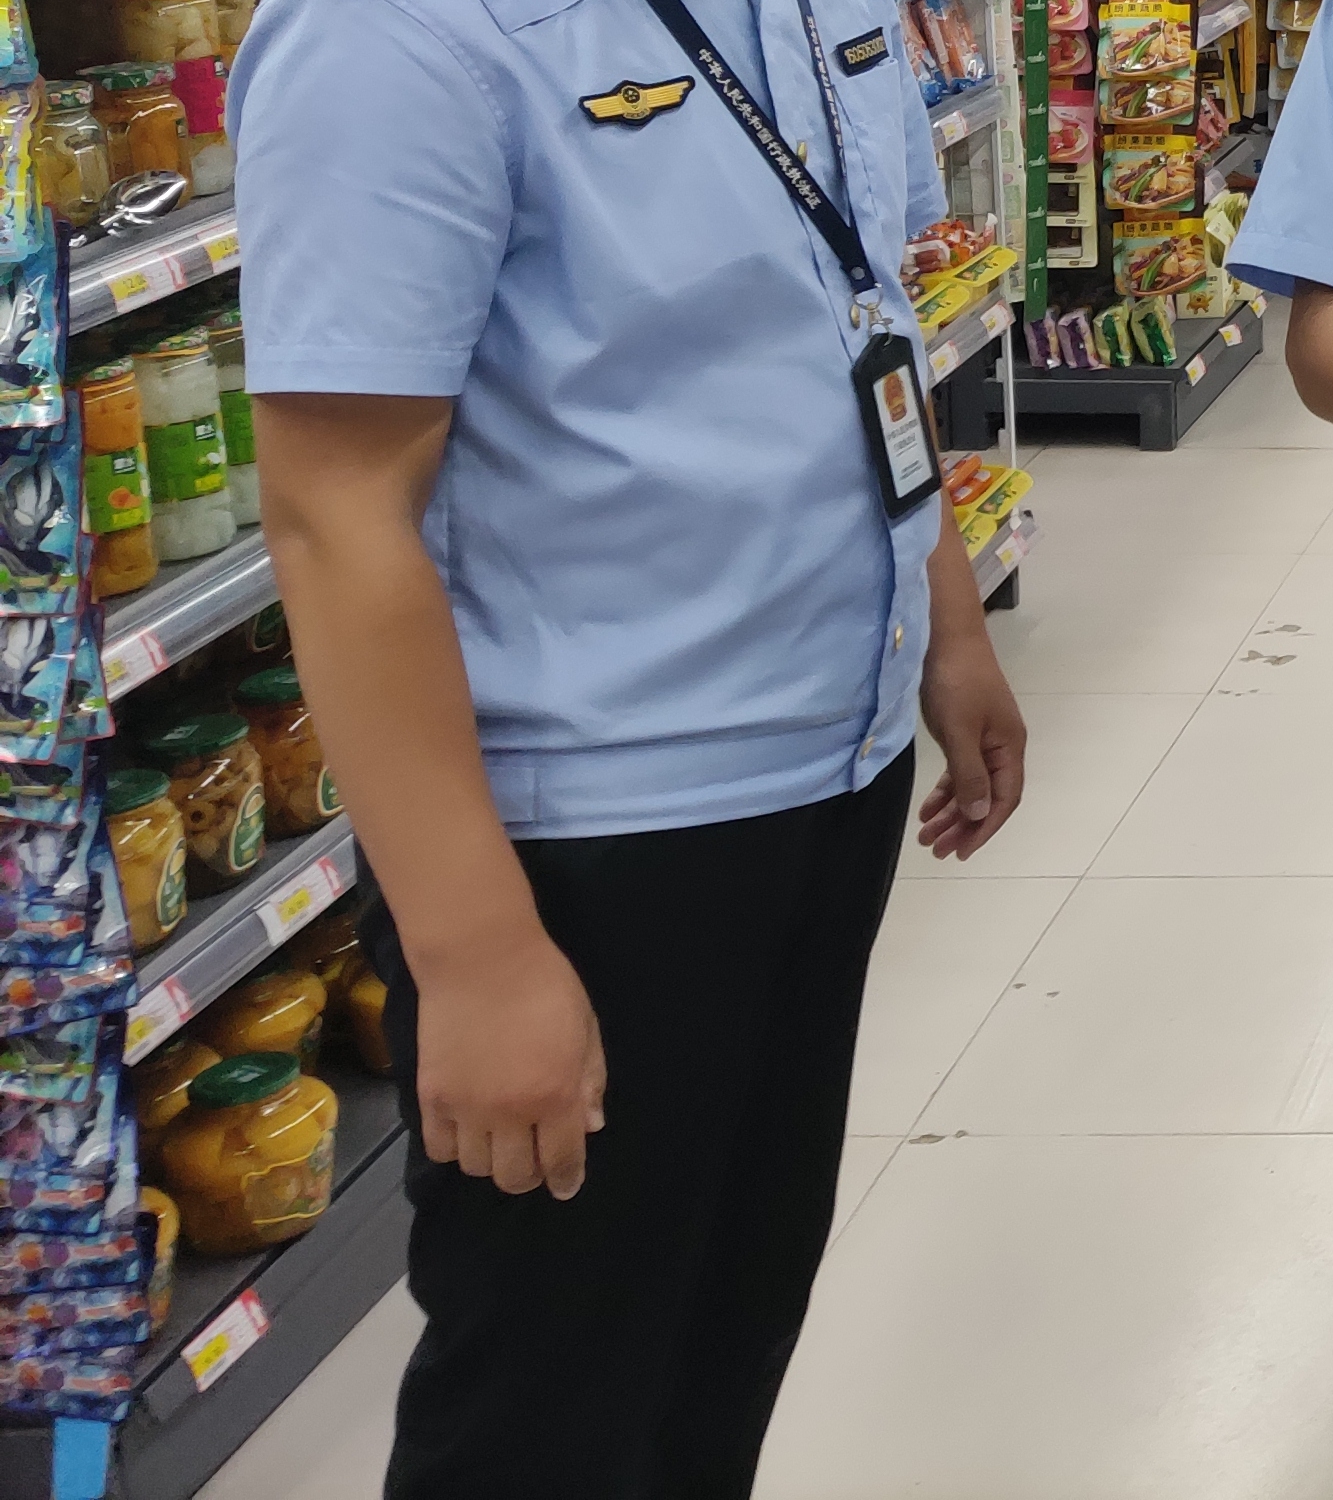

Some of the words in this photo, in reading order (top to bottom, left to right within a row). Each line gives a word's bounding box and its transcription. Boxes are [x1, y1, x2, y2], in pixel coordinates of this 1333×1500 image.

[697, 46, 823, 211] 中华人民共和国行政执法证
